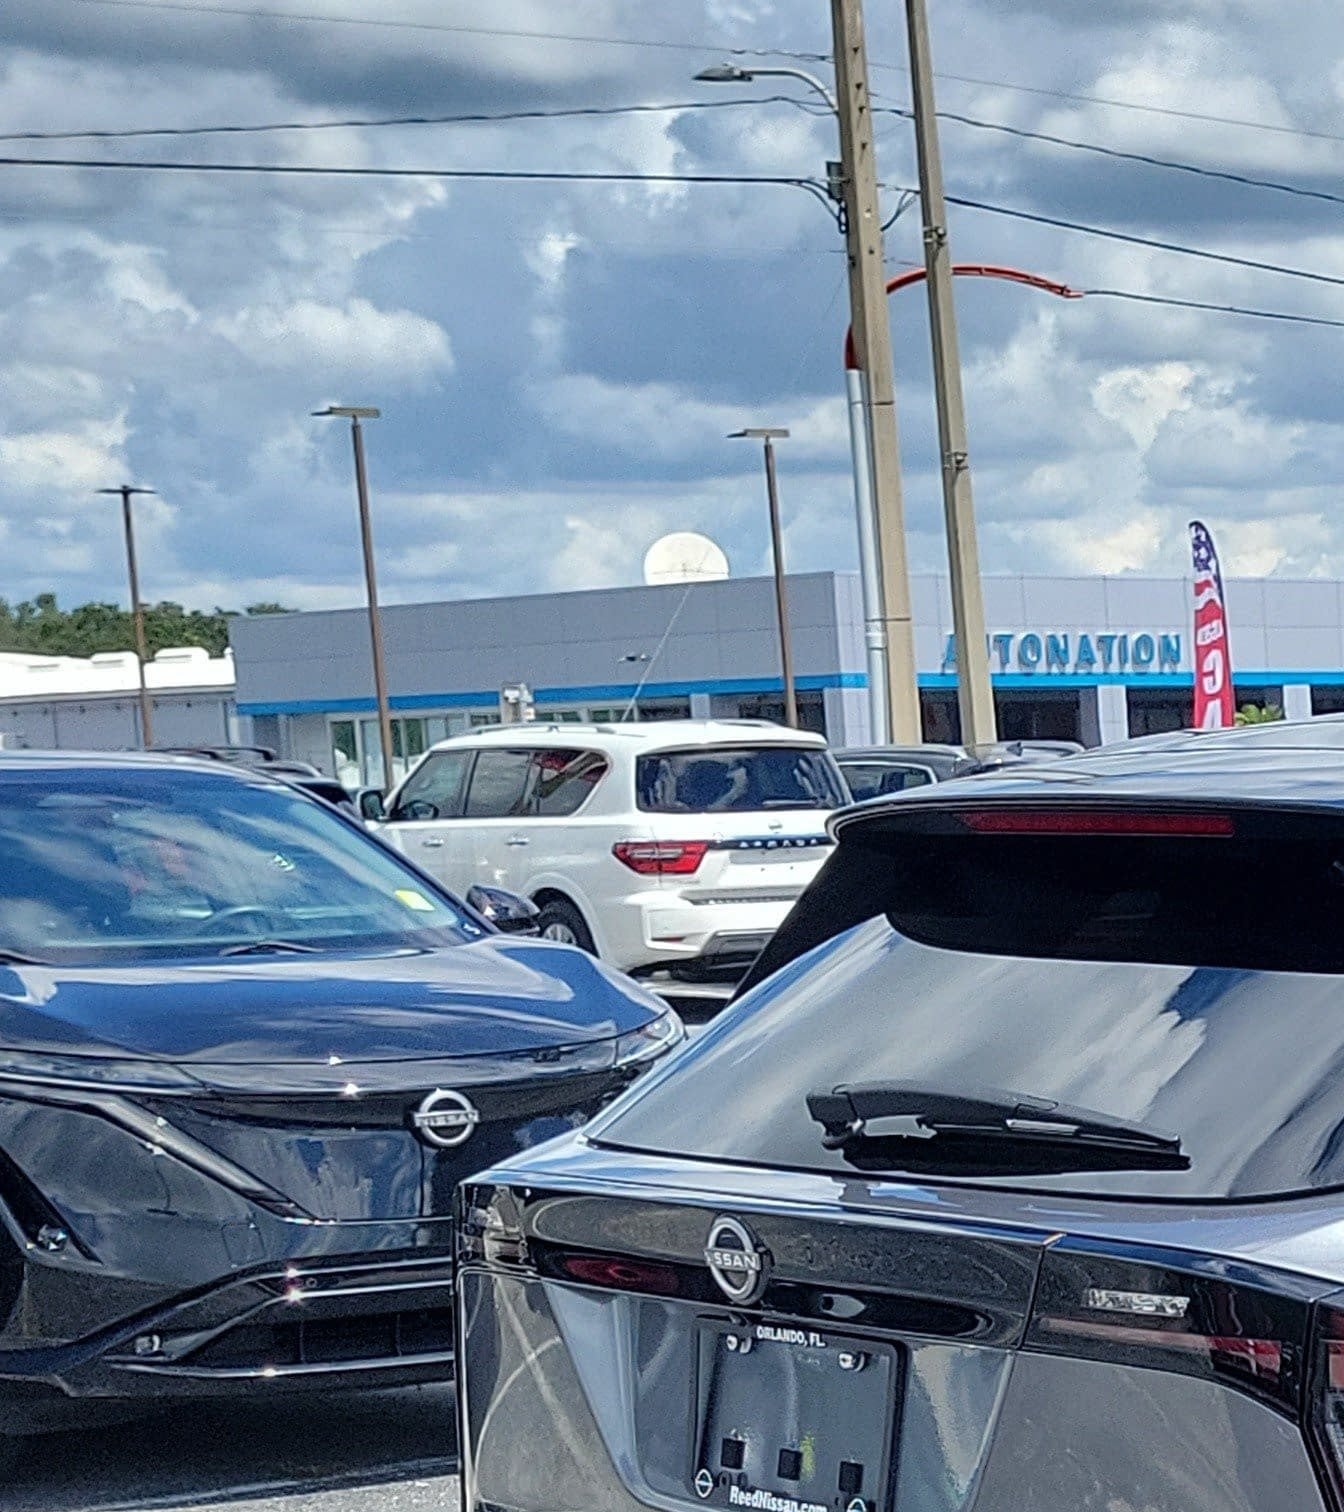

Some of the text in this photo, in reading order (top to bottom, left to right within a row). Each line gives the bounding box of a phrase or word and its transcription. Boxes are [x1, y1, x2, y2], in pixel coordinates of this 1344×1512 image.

[941, 631, 1182, 670] ATONATION
[704, 1249, 757, 1270] SSAN
[756, 1325, 808, 1347] ORLANDO,
